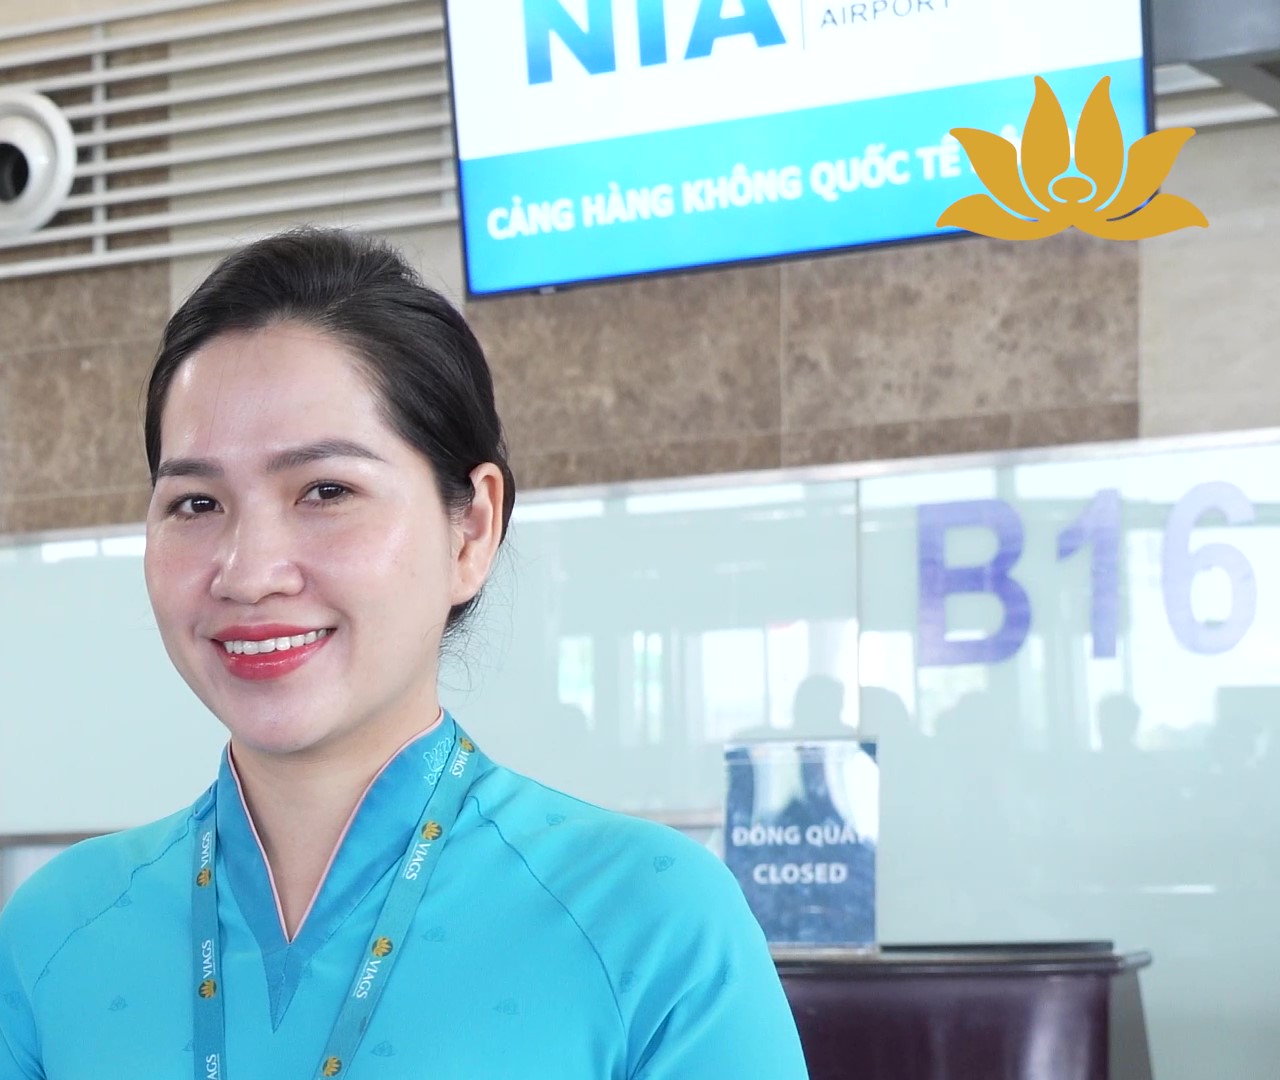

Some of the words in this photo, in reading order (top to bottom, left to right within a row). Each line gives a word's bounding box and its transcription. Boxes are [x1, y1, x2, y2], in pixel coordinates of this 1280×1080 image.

[820, 0, 950, 28] AIRPOR
[487, 195, 577, 241] CẢNG
[583, 180, 676, 229] HÀNG
[681, 160, 804, 214] KHÔNG
[809, 141, 911, 197] QUỐC
[916, 480, 1259, 668] B16
[200, 831, 211, 869] VIAGS
[405, 842, 431, 881] VIAGS
[753, 862, 847, 885] CLOSED
[202, 939, 212, 979] VIAGS
[356, 959, 380, 999] VIAGS
